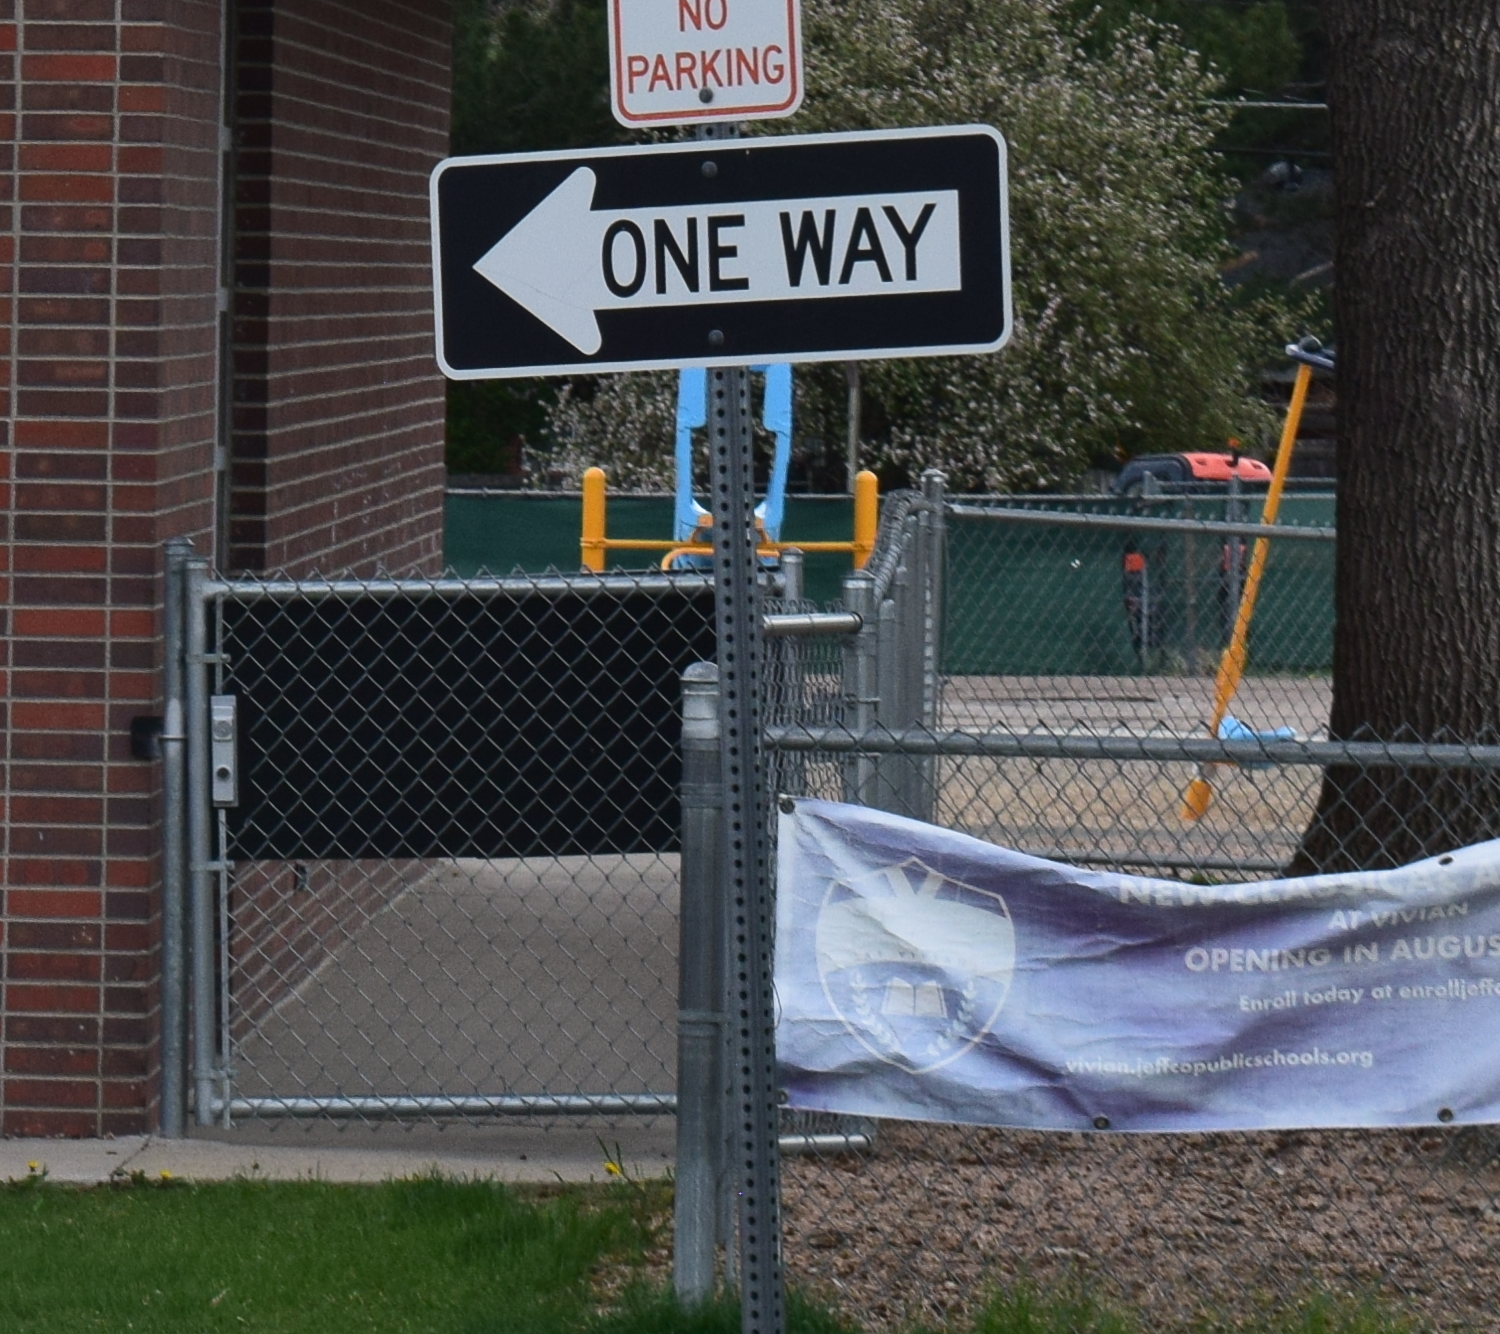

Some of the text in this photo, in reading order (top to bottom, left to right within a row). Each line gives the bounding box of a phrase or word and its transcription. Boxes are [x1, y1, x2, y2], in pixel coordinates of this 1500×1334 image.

[626, 45, 785, 94] PARKING
[601, 203, 936, 298] ONE WAY
[1329, 903, 1469, 931] AT VIVIAN
[1184, 947, 1332, 972] OPENING
[1343, 943, 1378, 964] IN
[1239, 988, 1298, 1011] Enroll
[1302, 985, 1364, 1006] today
[1371, 983, 1394, 1001] at
[1066, 1047, 1374, 1078] vivian.jeffcopublicschools.org
